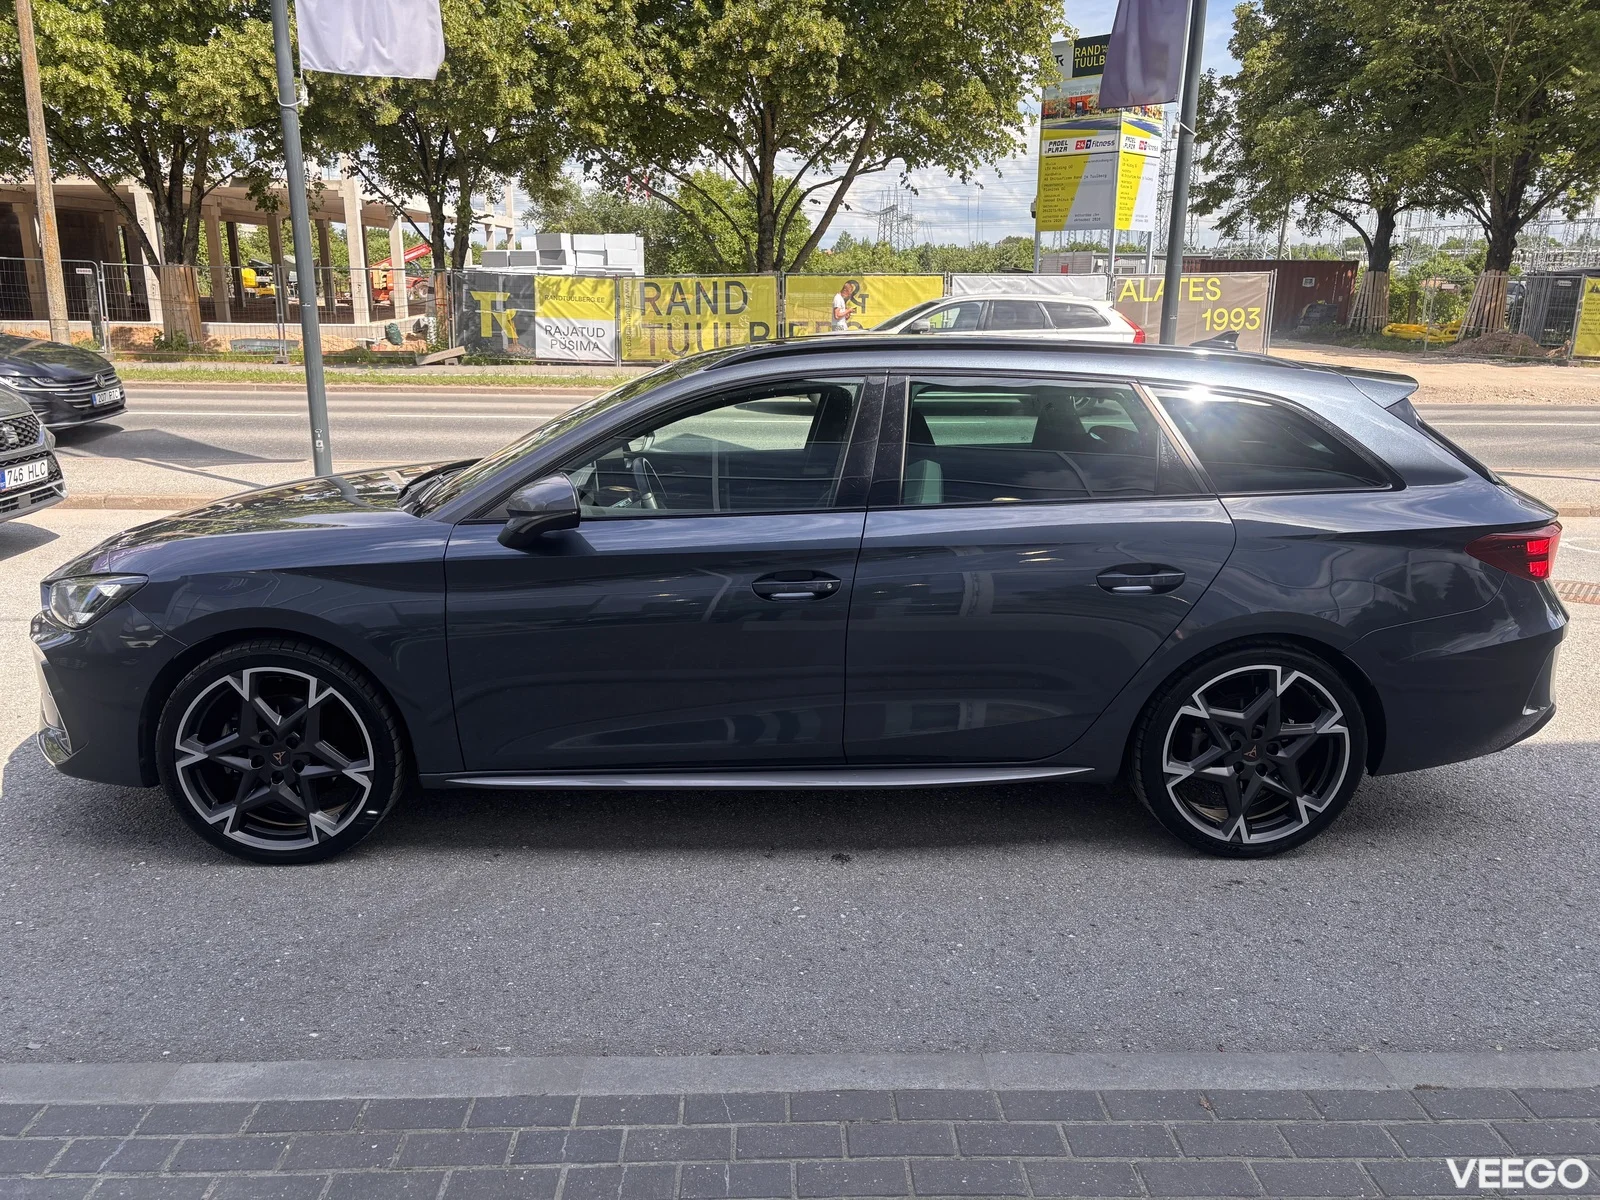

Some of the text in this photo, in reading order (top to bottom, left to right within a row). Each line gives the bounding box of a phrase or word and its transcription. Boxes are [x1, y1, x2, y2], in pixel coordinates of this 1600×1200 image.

[1075, 45, 1101, 58] RAND
[1074, 55, 1106, 69] TUULB
[640, 281, 748, 315] RAND
[1201, 307, 1261, 331] 1993
[545, 325, 606, 338] RAJATUD
[550, 337, 601, 351] PÜSIMA
[7, 462, 46, 485] 746 HLC
